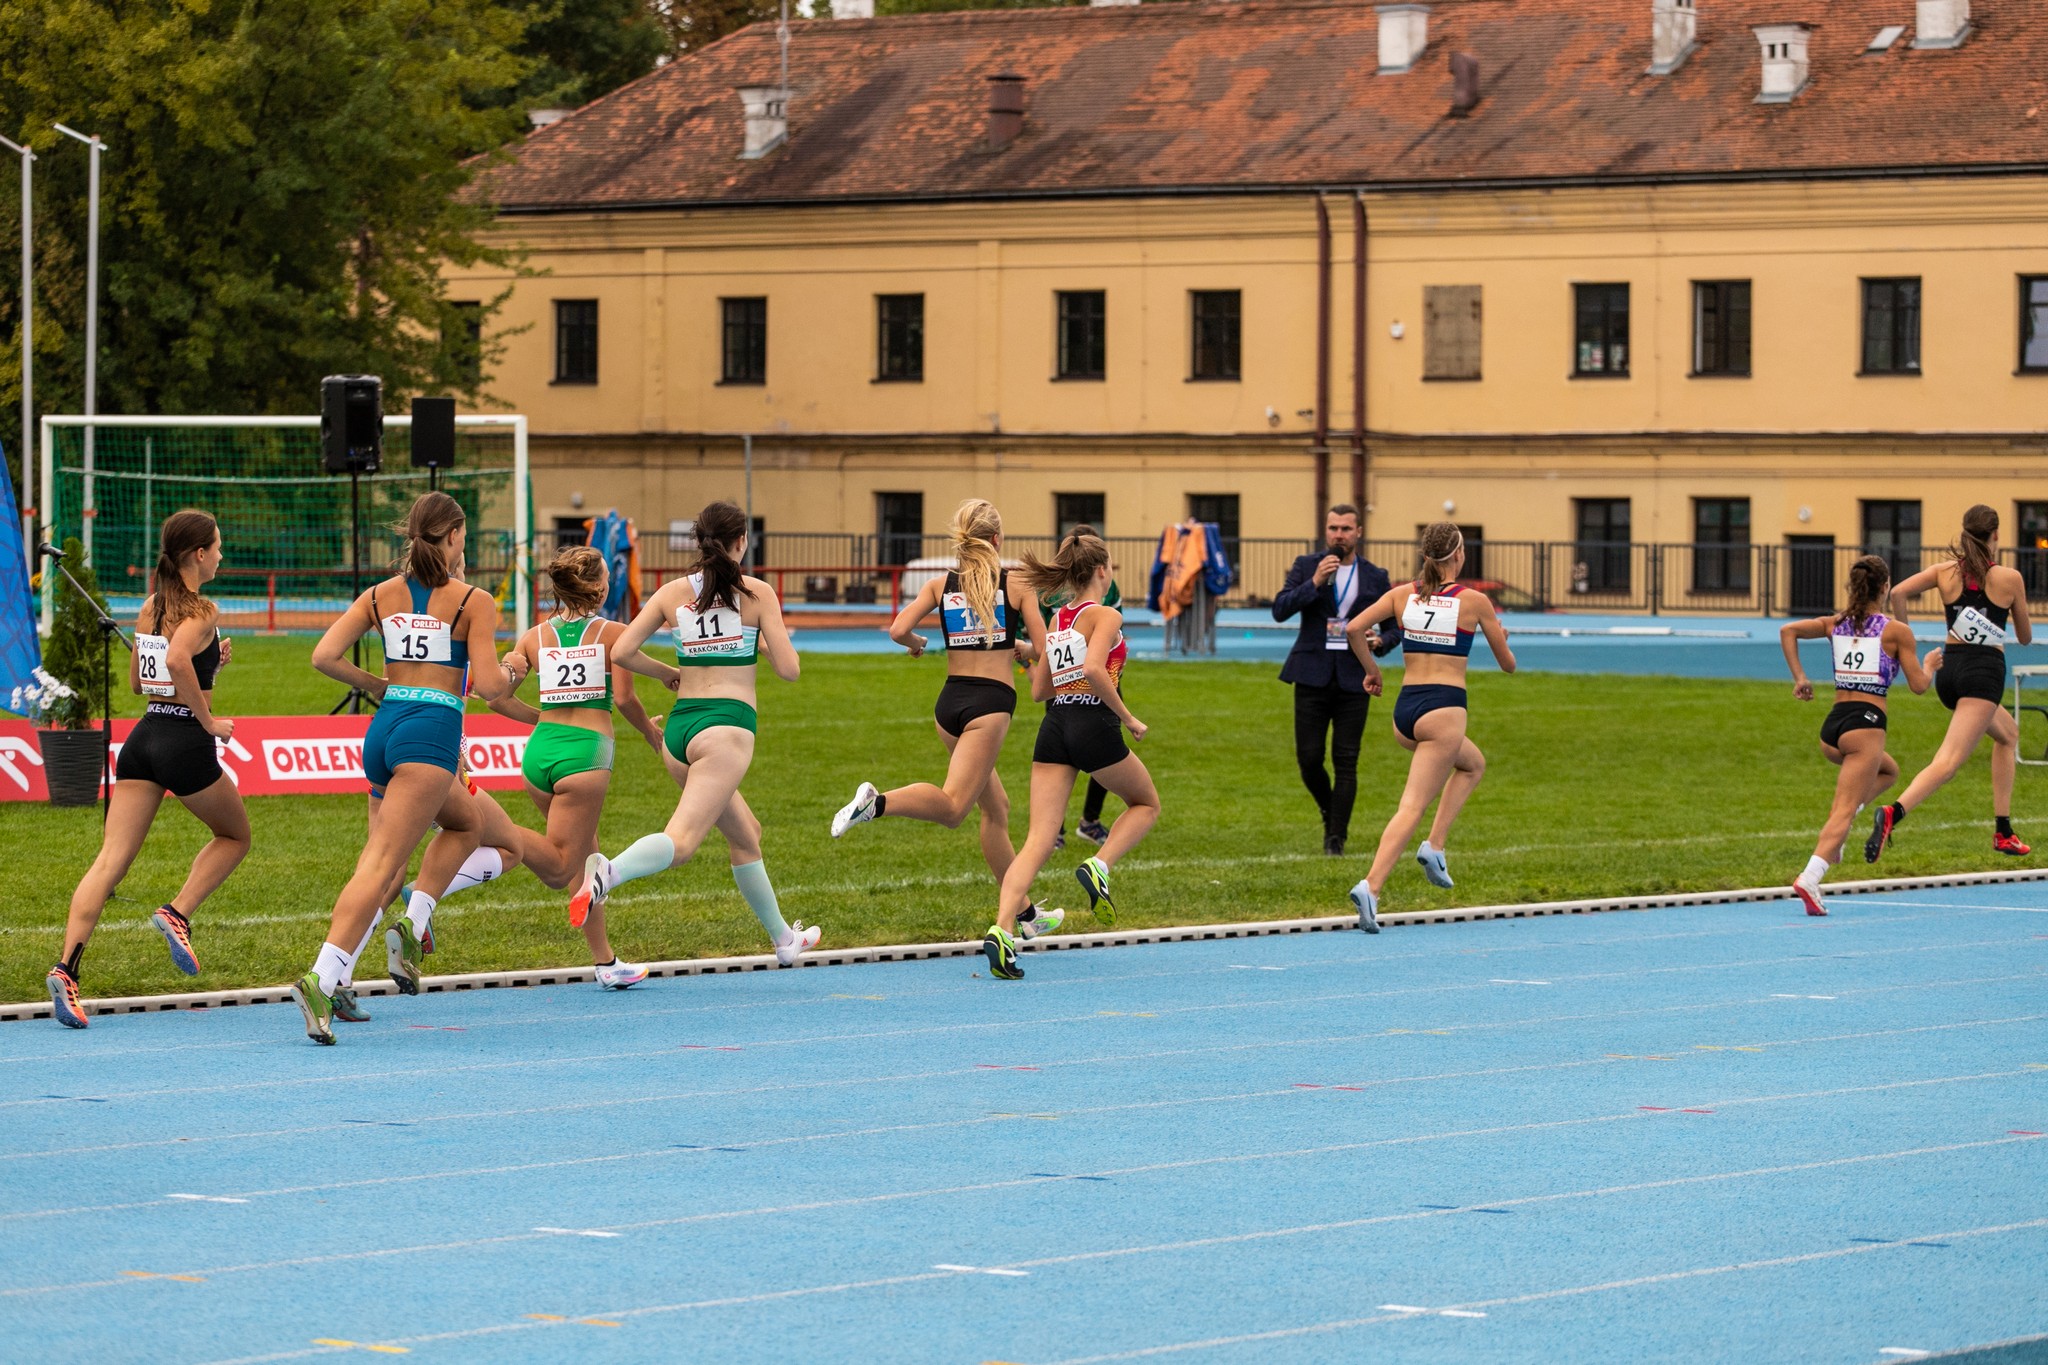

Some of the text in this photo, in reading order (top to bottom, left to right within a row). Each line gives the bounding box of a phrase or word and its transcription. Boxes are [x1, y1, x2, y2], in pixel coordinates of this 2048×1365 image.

[413, 620, 440, 629] ORLEN
[696, 614, 723, 638] 11
[1424, 611, 1435, 630] 7
[1976, 618, 2004, 639] Kraków
[1964, 627, 1987, 645] 31
[402, 634, 429, 659] 15
[568, 649, 595, 658] ORLEN
[688, 642, 738, 653] KRAKÓW 2022
[141, 654, 156, 679] 28
[1054, 645, 1074, 670] 24
[1843, 652, 1865, 670] 49
[557, 663, 587, 687] 23
[547, 693, 580, 702] KRAKÓW
[1858, 684, 1885, 695] NIKE
[272, 745, 364, 773] ORLEN
[469, 743, 525, 769] ORL
